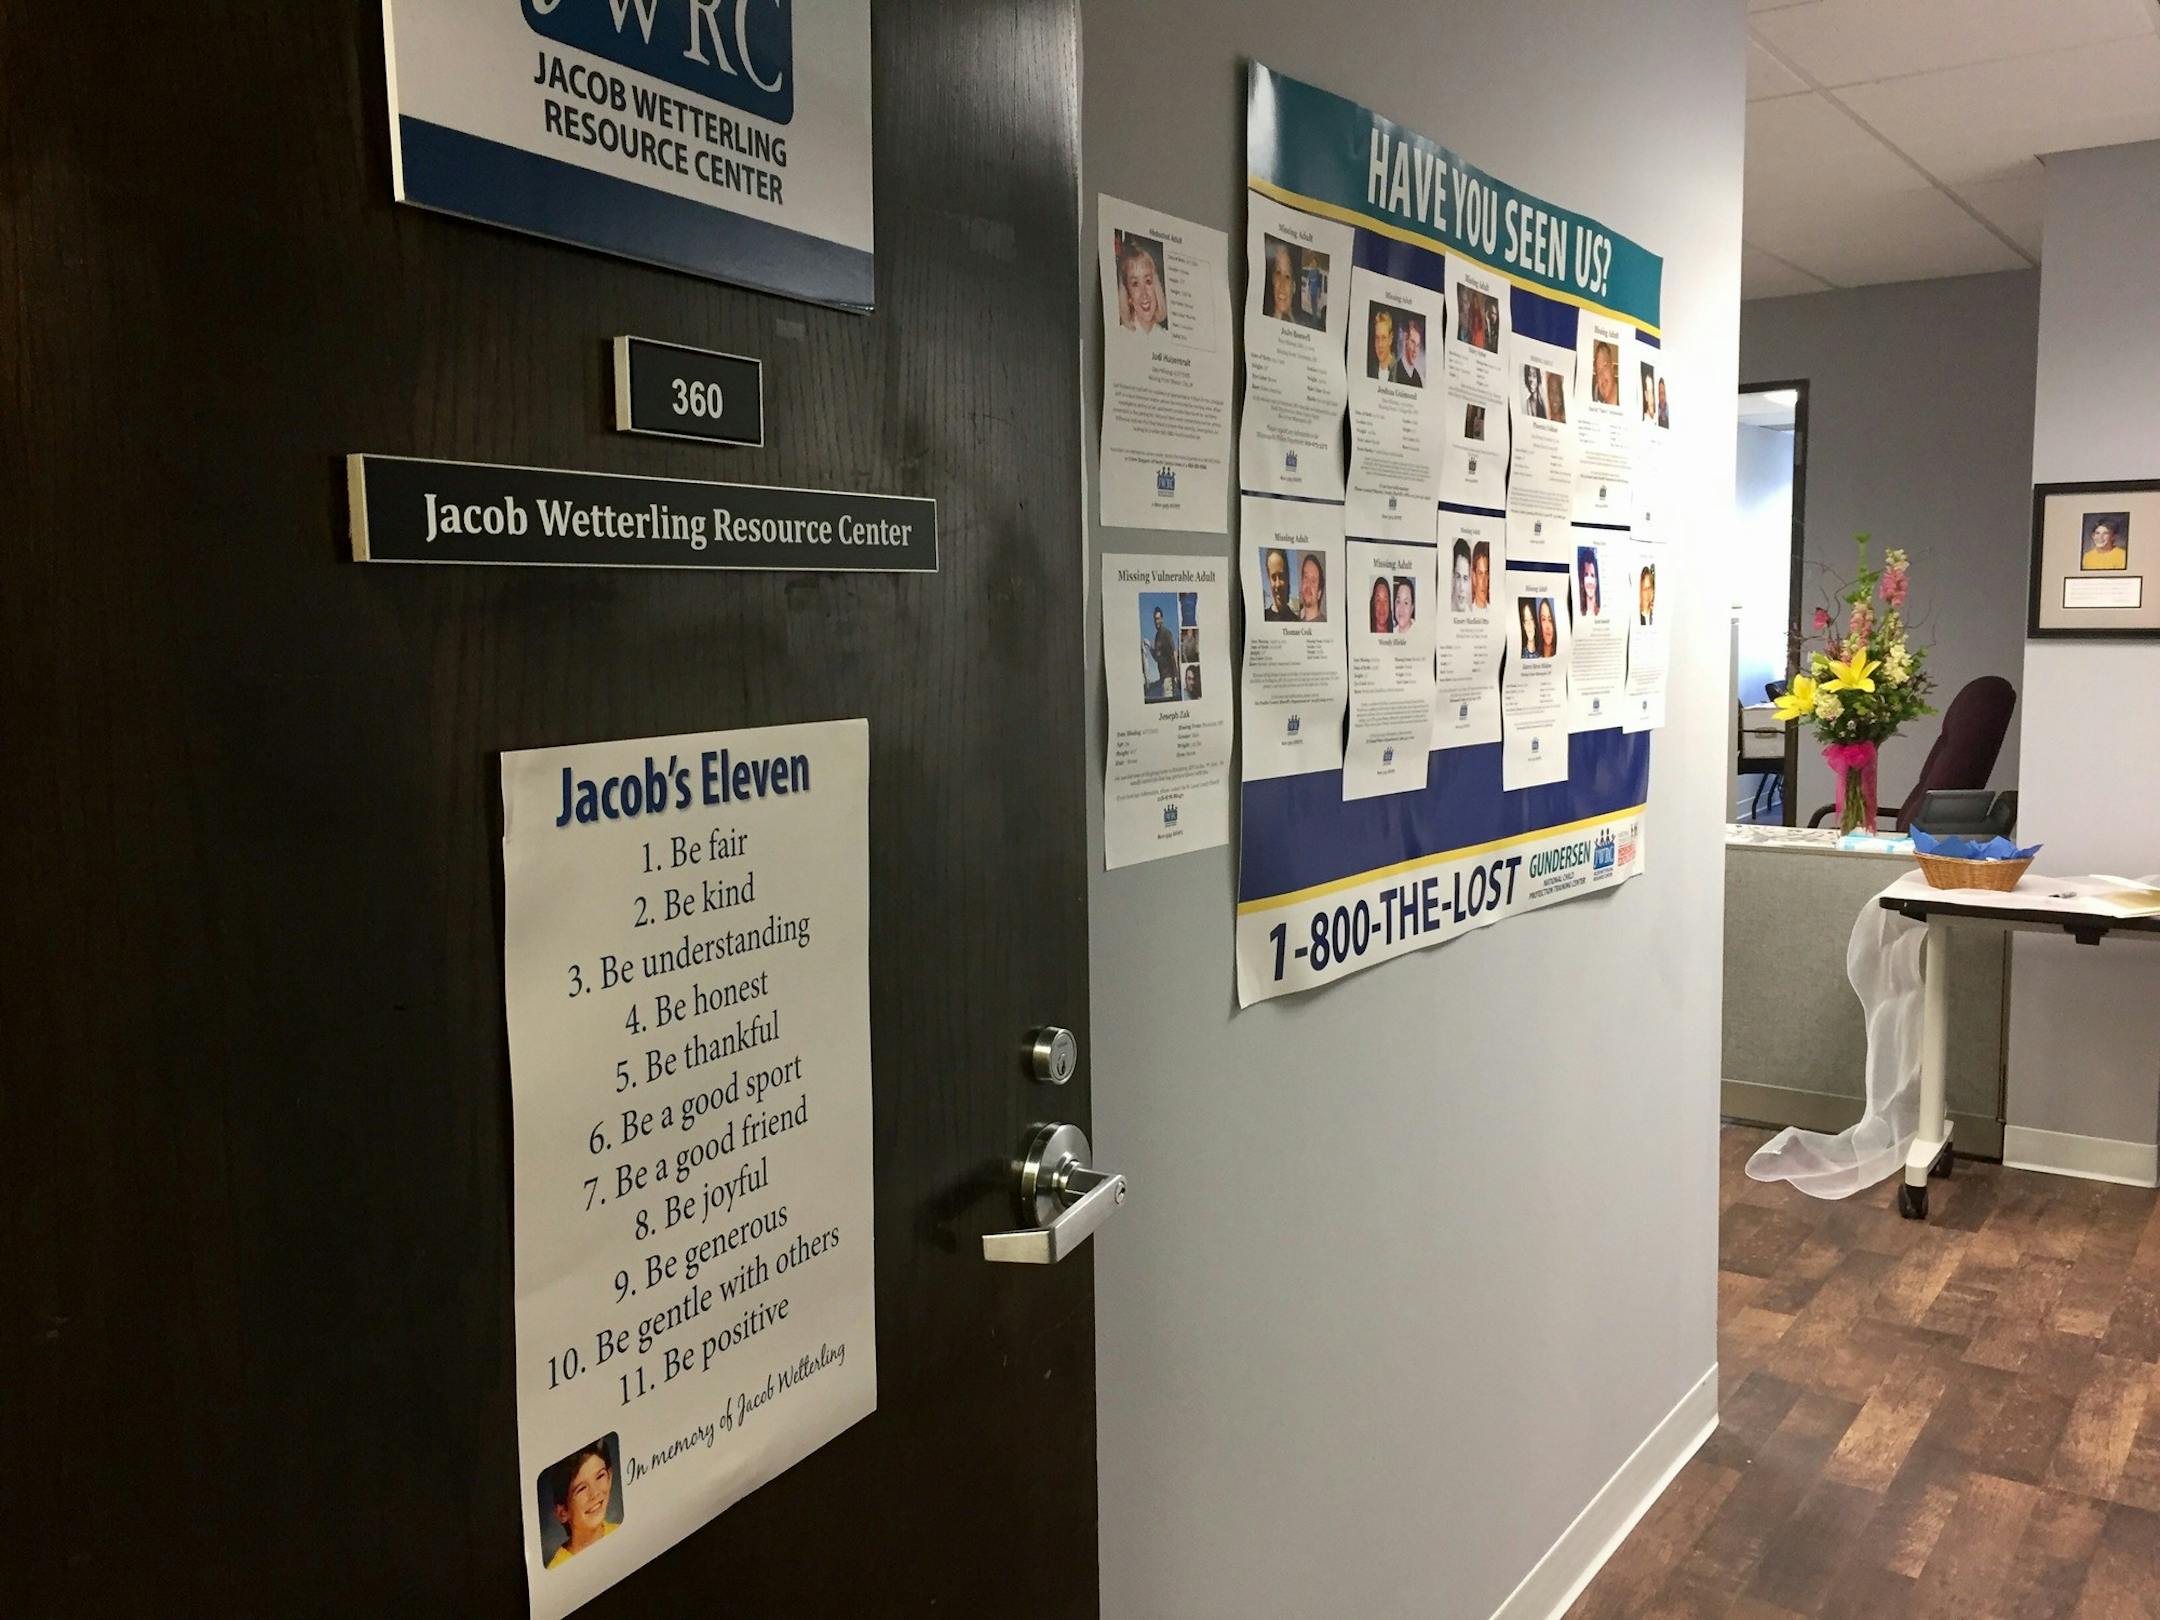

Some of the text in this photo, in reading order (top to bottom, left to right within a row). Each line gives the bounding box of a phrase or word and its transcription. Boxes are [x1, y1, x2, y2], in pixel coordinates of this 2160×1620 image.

[533, 51, 787, 168] JACOB WETTERLING
[544, 98, 784, 205] RESOURCE CENTER
[1367, 127, 1612, 297] HAVE YOU SEEN US?
[671, 378, 724, 419] 360
[424, 493, 912, 549] Jacob Wetterling Resource Center
[1117, 569, 1216, 585] Missing Vulnerable Adult
[1372, 558, 1413, 571] Missing Adult
[1158, 710, 1179, 724] Joseph
[556, 748, 810, 828] Jacob's Eleven
[643, 827, 748, 873] 1. Be fair
[1529, 840, 1591, 879] GUNDERSEN
[634, 872, 756, 928] 2. Be kind
[1268, 855, 1522, 981] 1-800-THE-LOST
[568, 915, 811, 998] 3. Be understanding
[625, 970, 768, 1035] 4. Be honest
[616, 1009, 780, 1093] 5. Be thankful
[589, 1055, 803, 1155] 6. Be a good sport
[583, 1094, 808, 1211] 7. Be a good friend
[635, 1156, 769, 1241] 8. Be joyful
[614, 1206, 788, 1304] 9. Be generous
[548, 1227, 840, 1390] 10. Be gentle with others
[619, 1298, 790, 1406] 11. Be positive
[626, 1343, 847, 1486] In memory of Jacob Wetterling
